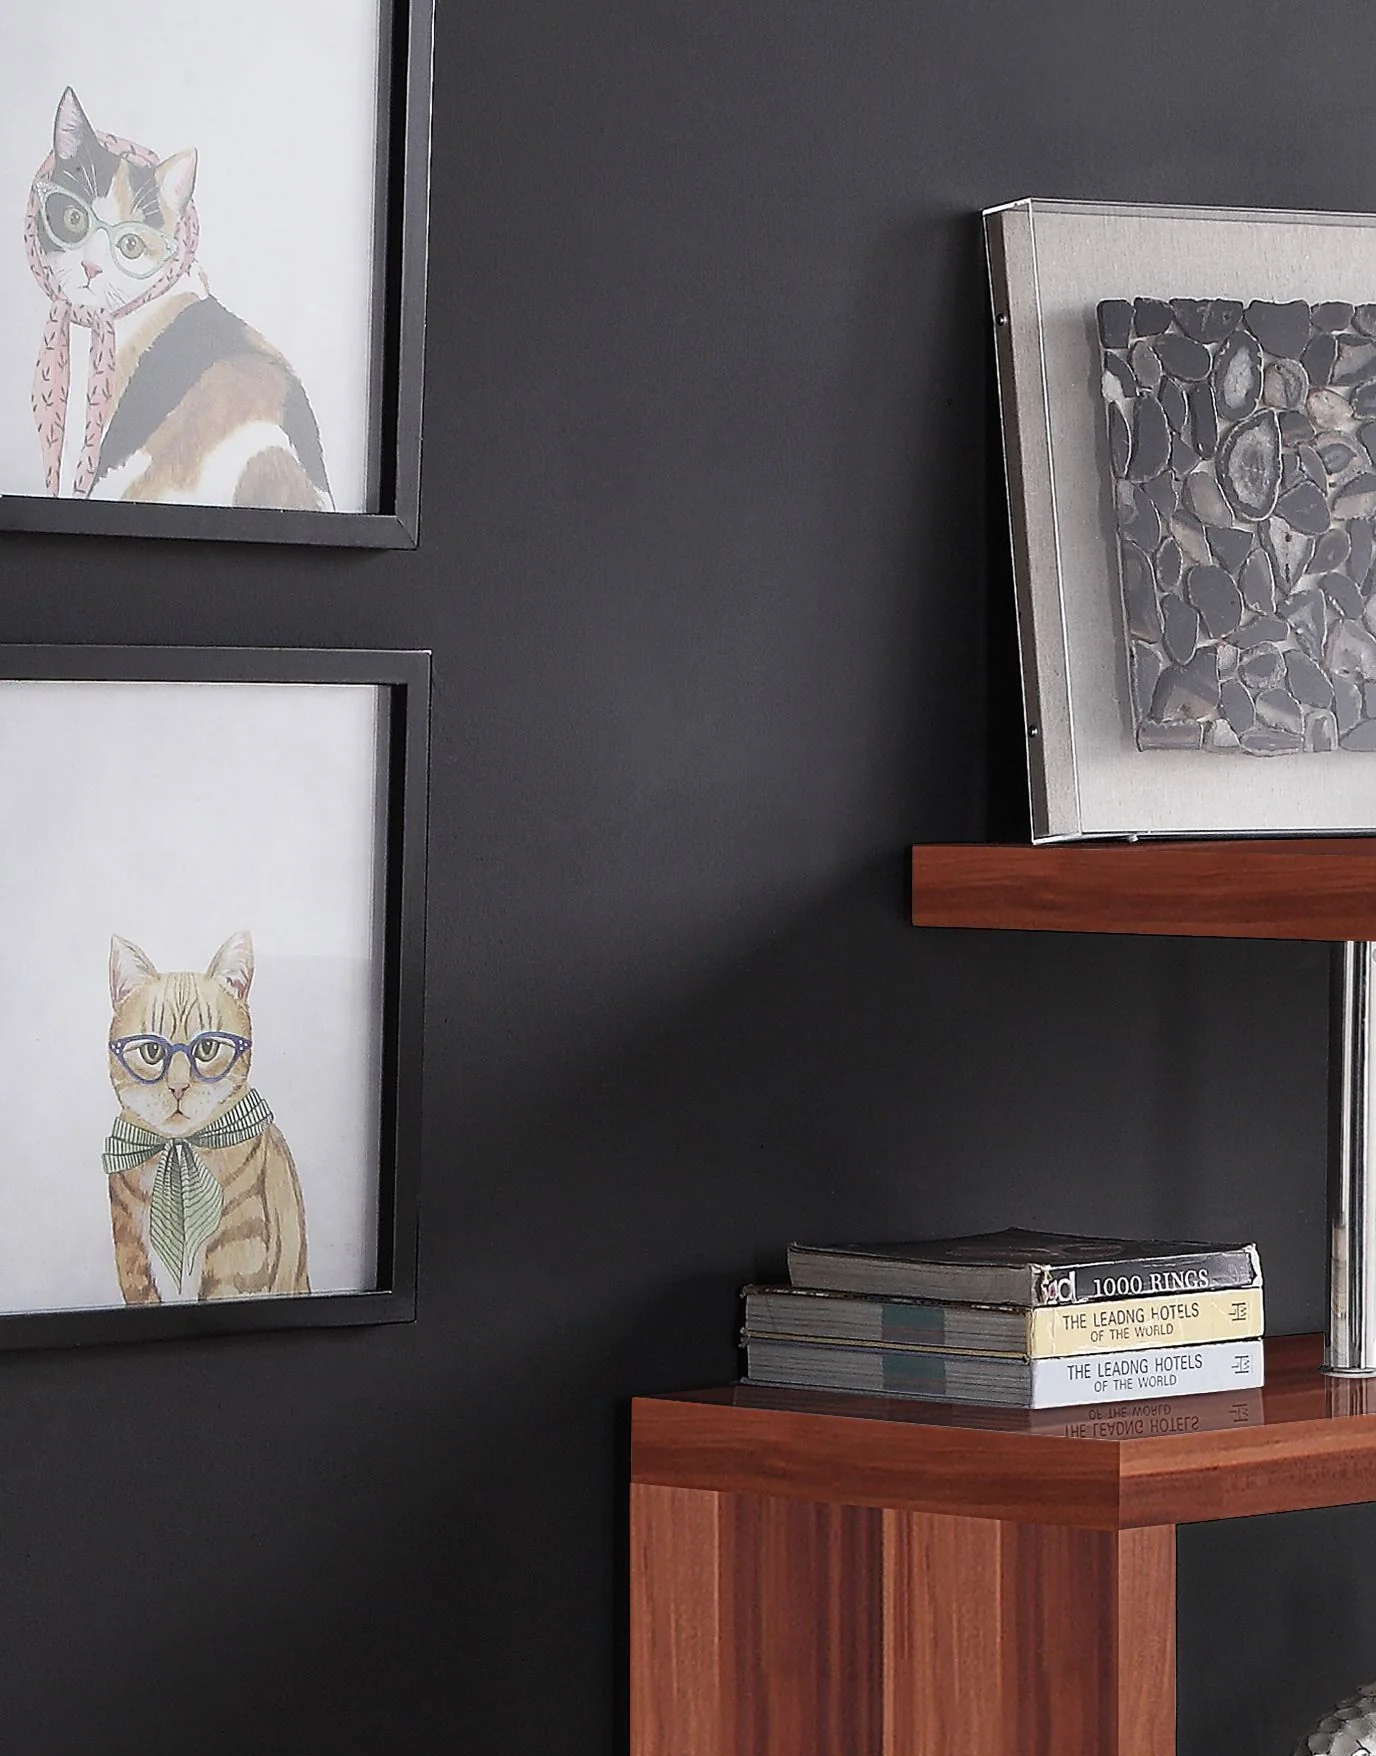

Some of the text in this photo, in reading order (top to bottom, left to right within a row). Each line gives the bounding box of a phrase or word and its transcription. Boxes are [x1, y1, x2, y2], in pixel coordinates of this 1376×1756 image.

[1093, 1269, 1209, 1297] 1000 RINGS
[1063, 1313, 1087, 1330] THE
[1151, 1302, 1200, 1321] HOTELS
[1090, 1323, 1174, 1342] OF THE WORLD
[1067, 1363, 1091, 1380] THE
[1155, 1353, 1203, 1372] HOTELS
[1094, 1374, 1177, 1393] OF THE WORLD
